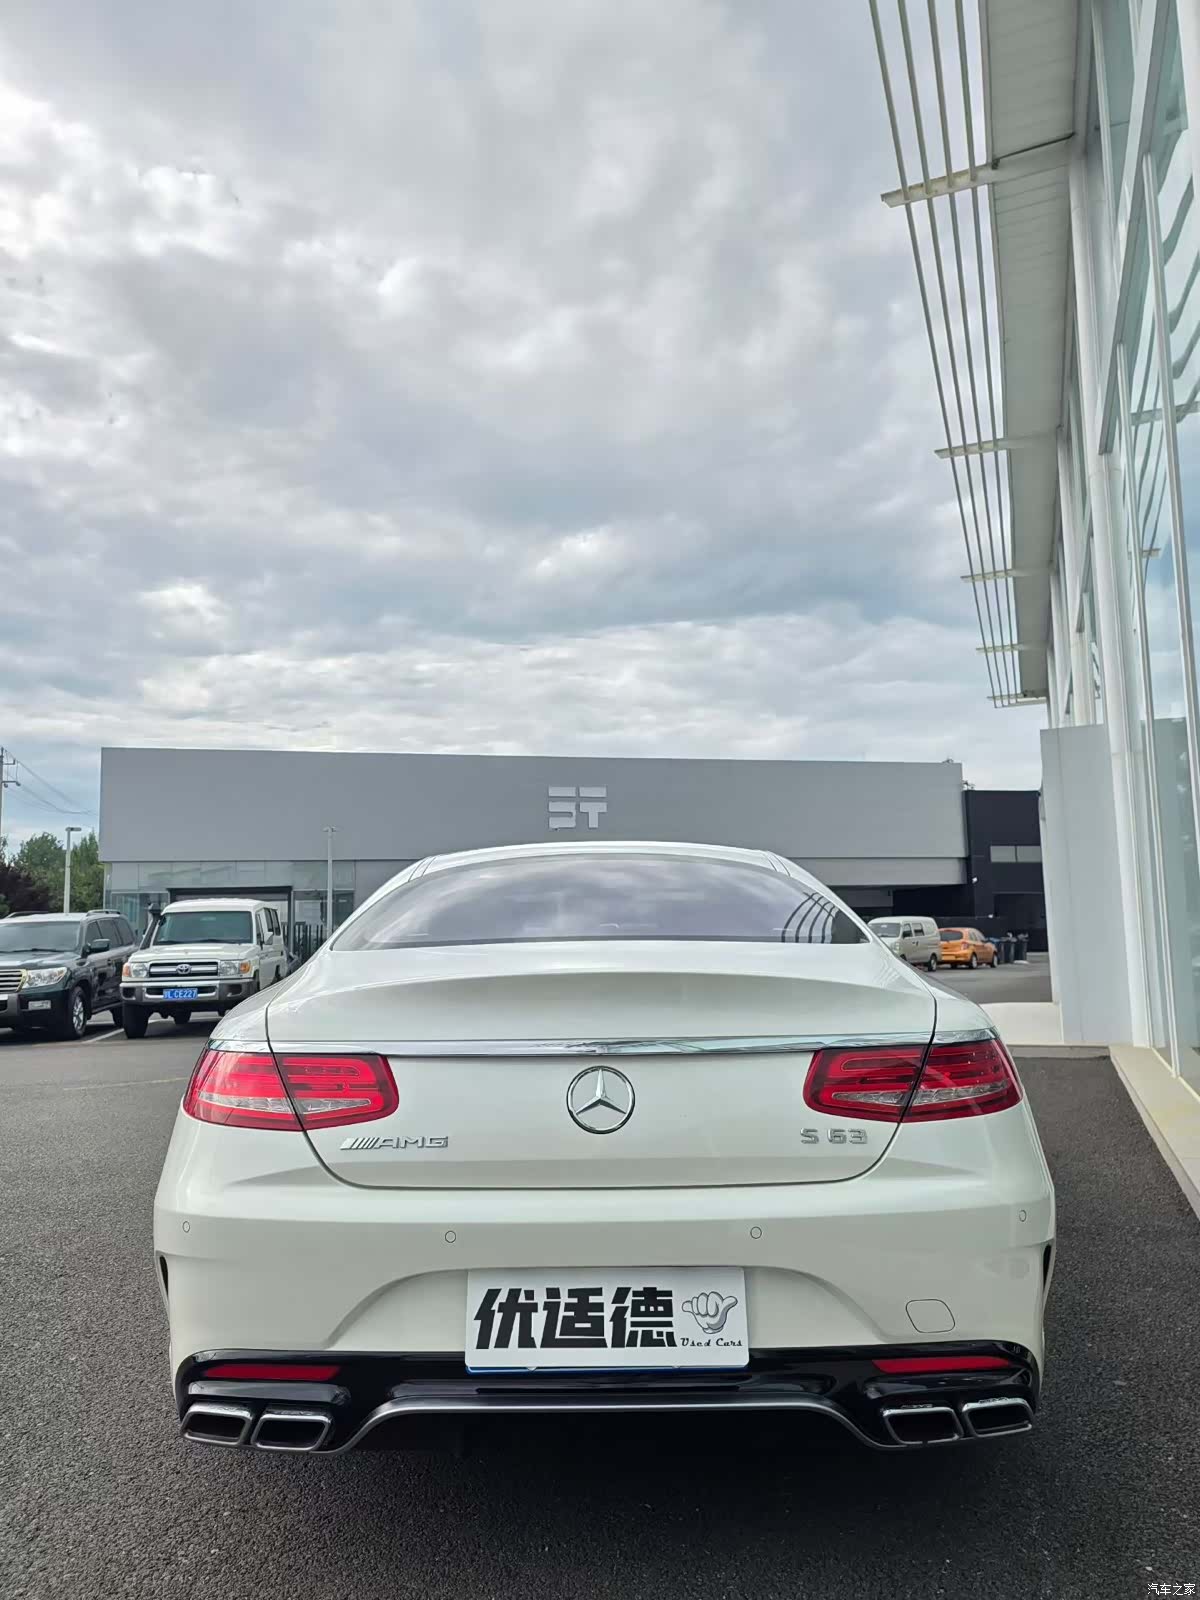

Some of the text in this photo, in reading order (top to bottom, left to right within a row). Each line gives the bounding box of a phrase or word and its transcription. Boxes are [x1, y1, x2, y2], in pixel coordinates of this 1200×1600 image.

[372, 1135, 449, 1150] AMG
[800, 1127, 869, 1145] S 63
[473, 1286, 678, 1350] 优适德
[680, 1337, 743, 1347] Used Cars
